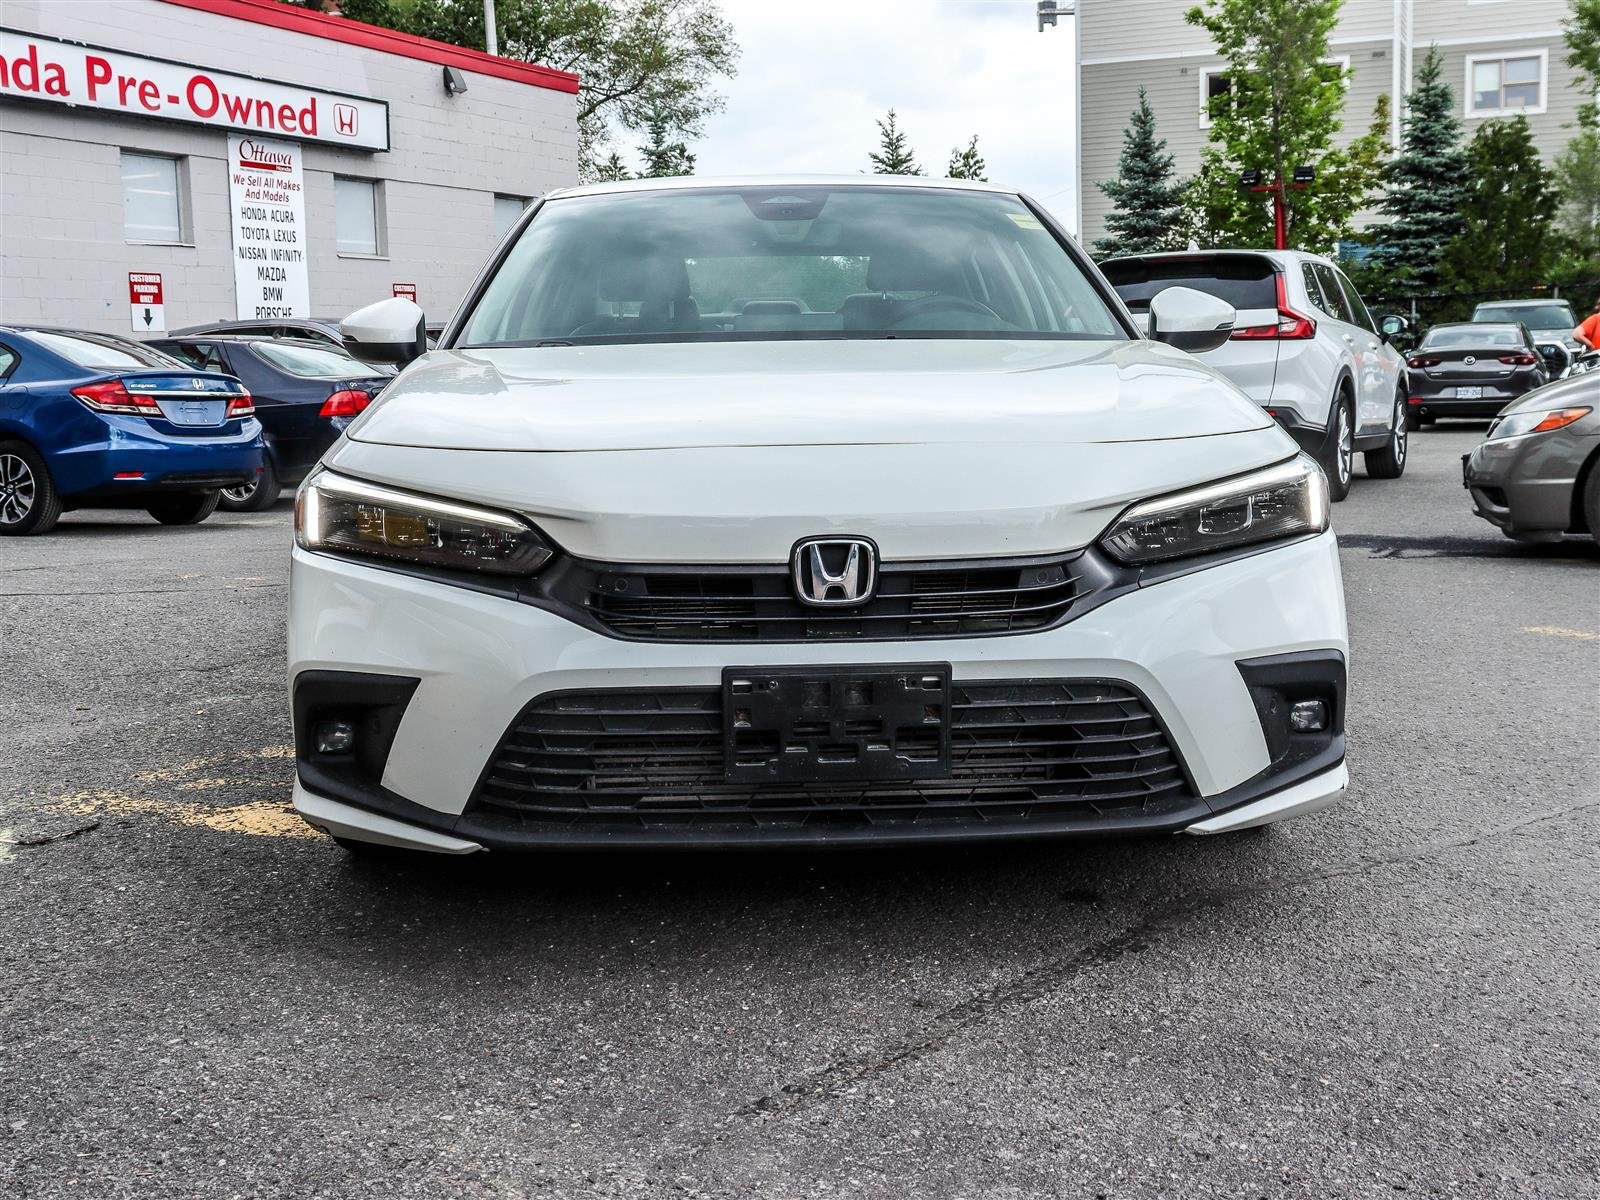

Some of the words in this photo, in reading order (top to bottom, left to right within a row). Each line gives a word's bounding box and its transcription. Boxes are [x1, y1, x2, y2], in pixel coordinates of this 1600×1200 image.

[85, 55, 318, 136] Pre-Owned
[239, 139, 292, 164] Ottawa
[233, 174, 245, 185] We
[247, 176, 262, 187] Sell
[263, 178, 274, 188] All
[276, 180, 301, 191] Makes
[245, 188, 260, 199] And
[262, 191, 289, 202] Models
[241, 207, 267, 221] HONDA
[270, 209, 295, 223] ACURA
[241, 226, 270, 240] TOYOTA
[273, 229, 297, 243] LEXUS
[239, 246, 267, 260] NISSAN
[271, 249, 302, 262] INFINITY
[257, 266, 287, 282] MAZDA
[134, 285, 158, 293] PARKING
[263, 287, 283, 301] BMW
[256, 306, 292, 319] PORSCHE
